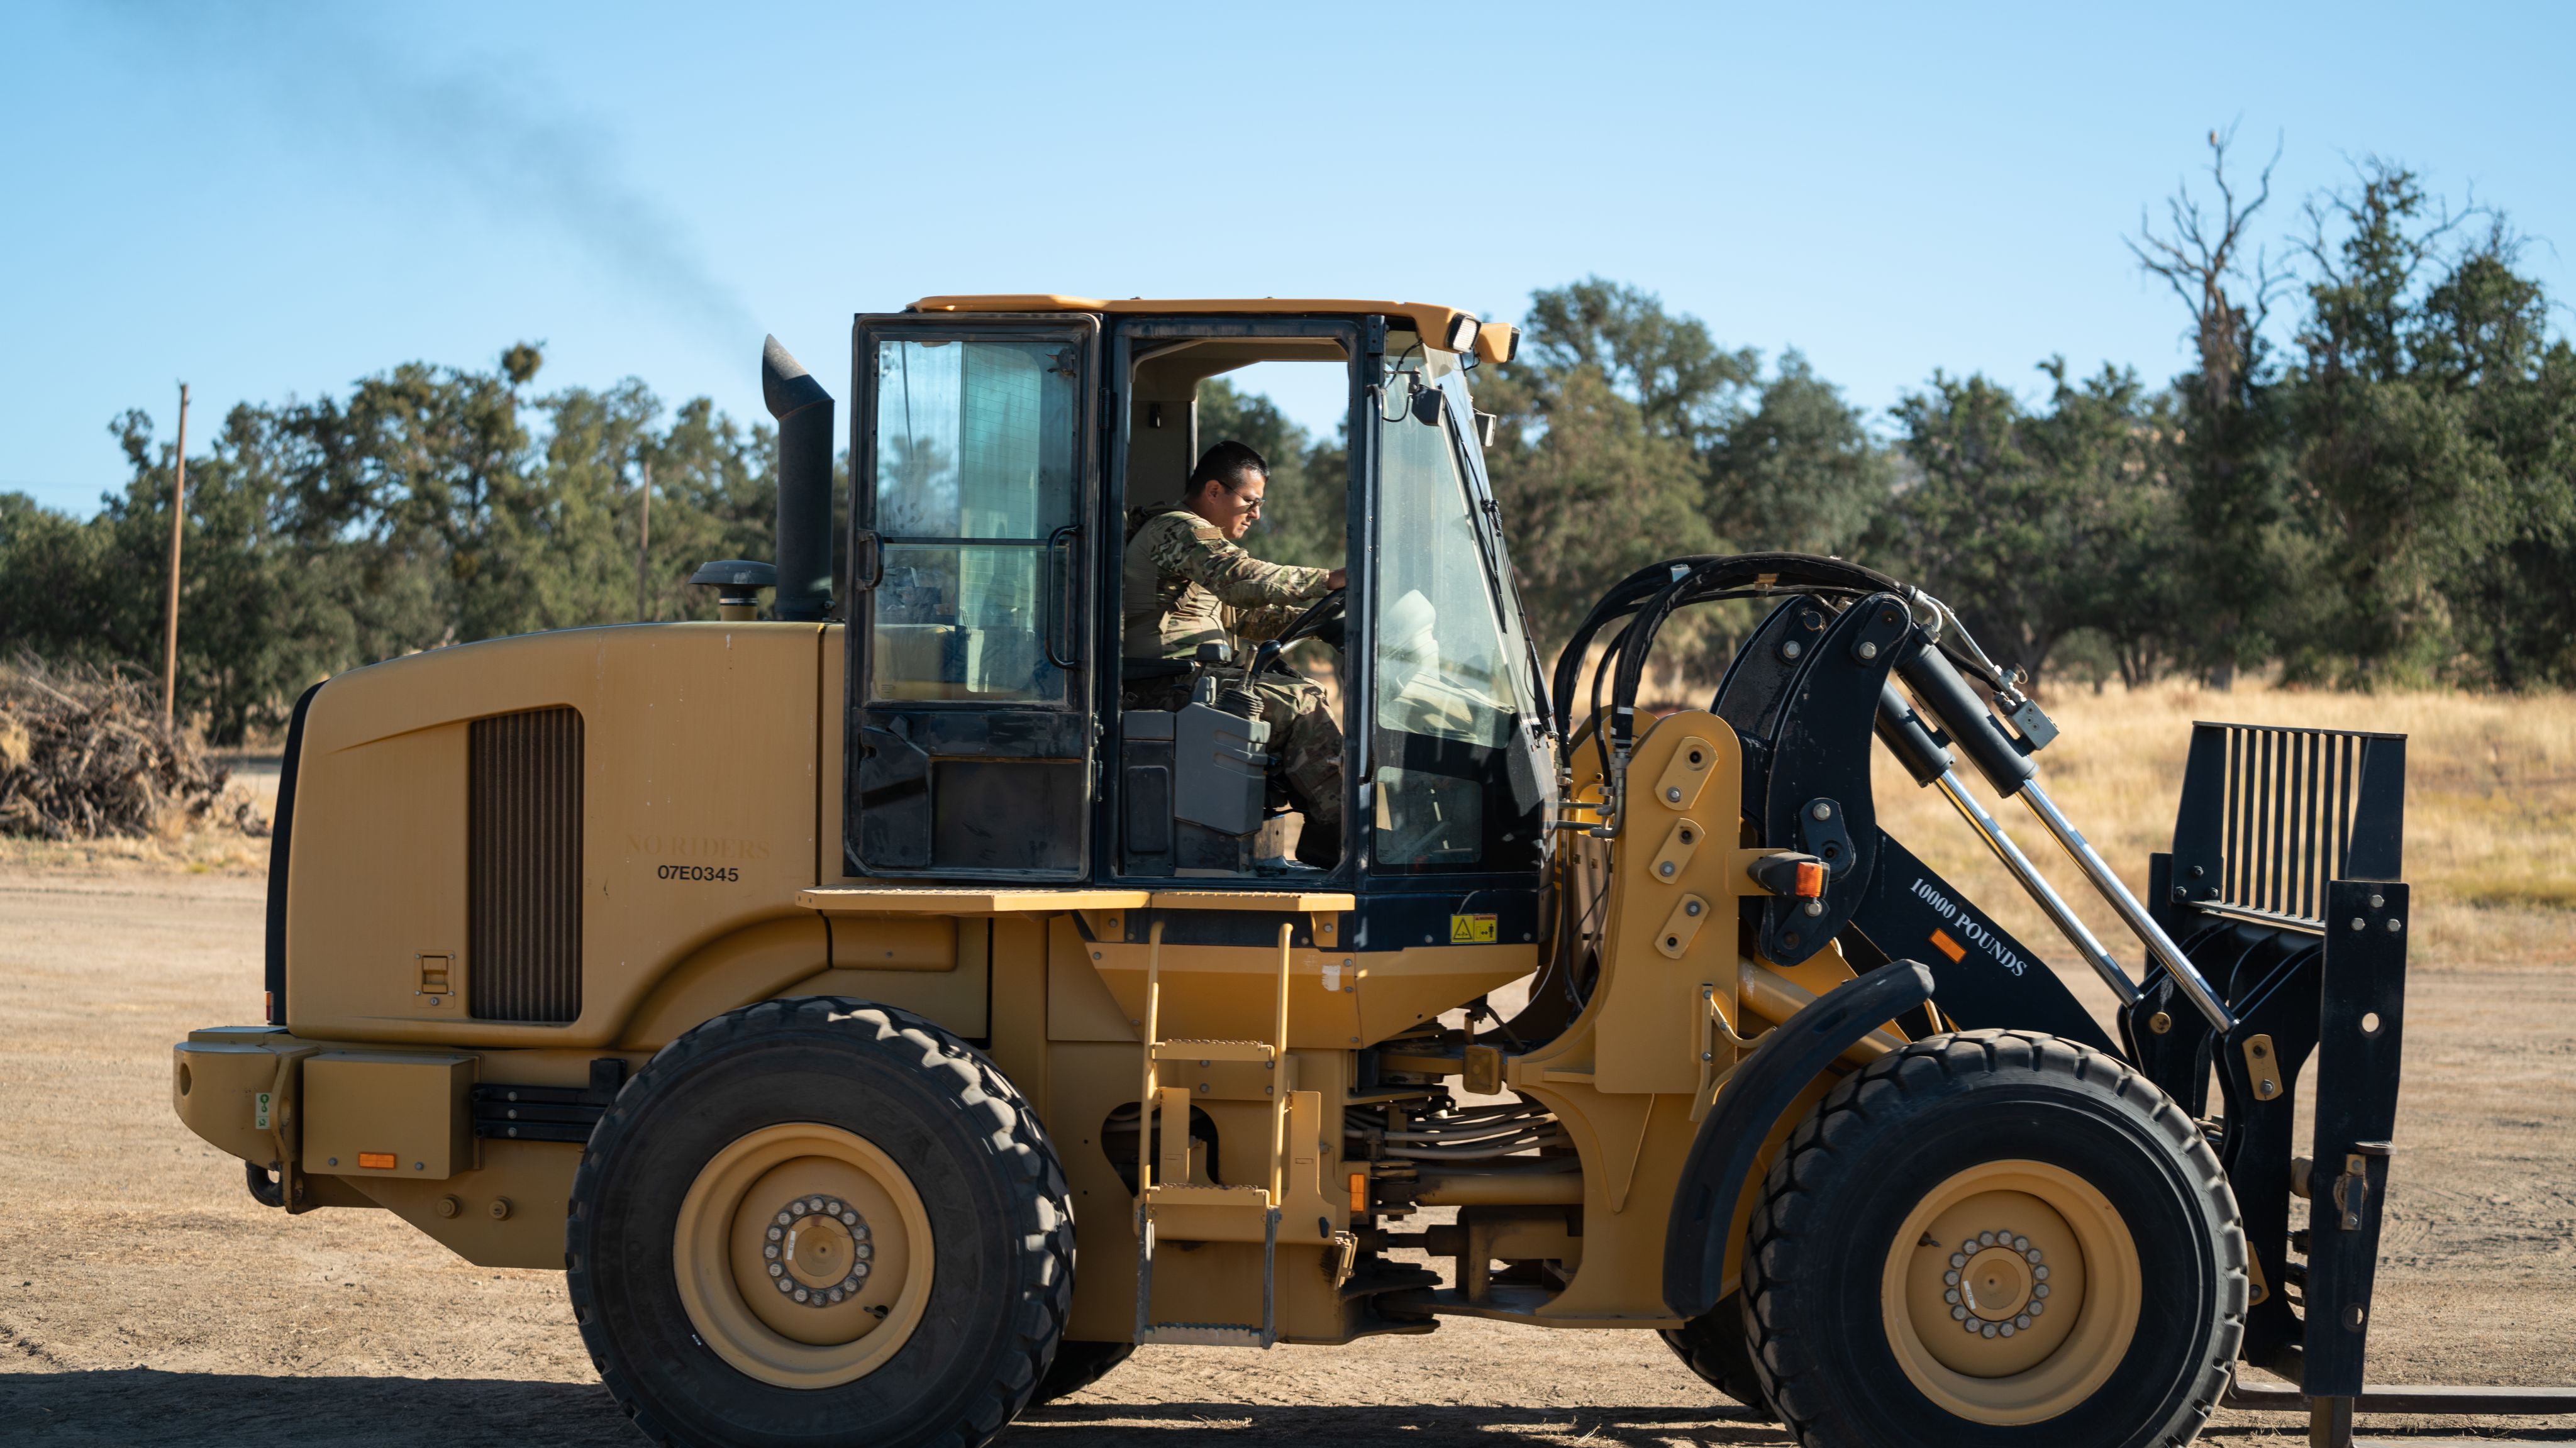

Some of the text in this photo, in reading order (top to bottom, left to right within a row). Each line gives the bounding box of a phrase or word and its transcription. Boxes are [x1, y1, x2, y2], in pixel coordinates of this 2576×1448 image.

[626, 834, 770, 860] NO RIDERS
[657, 865, 739, 882] 07E0345
[1909, 878, 2028, 976] 10000 POUNDS
